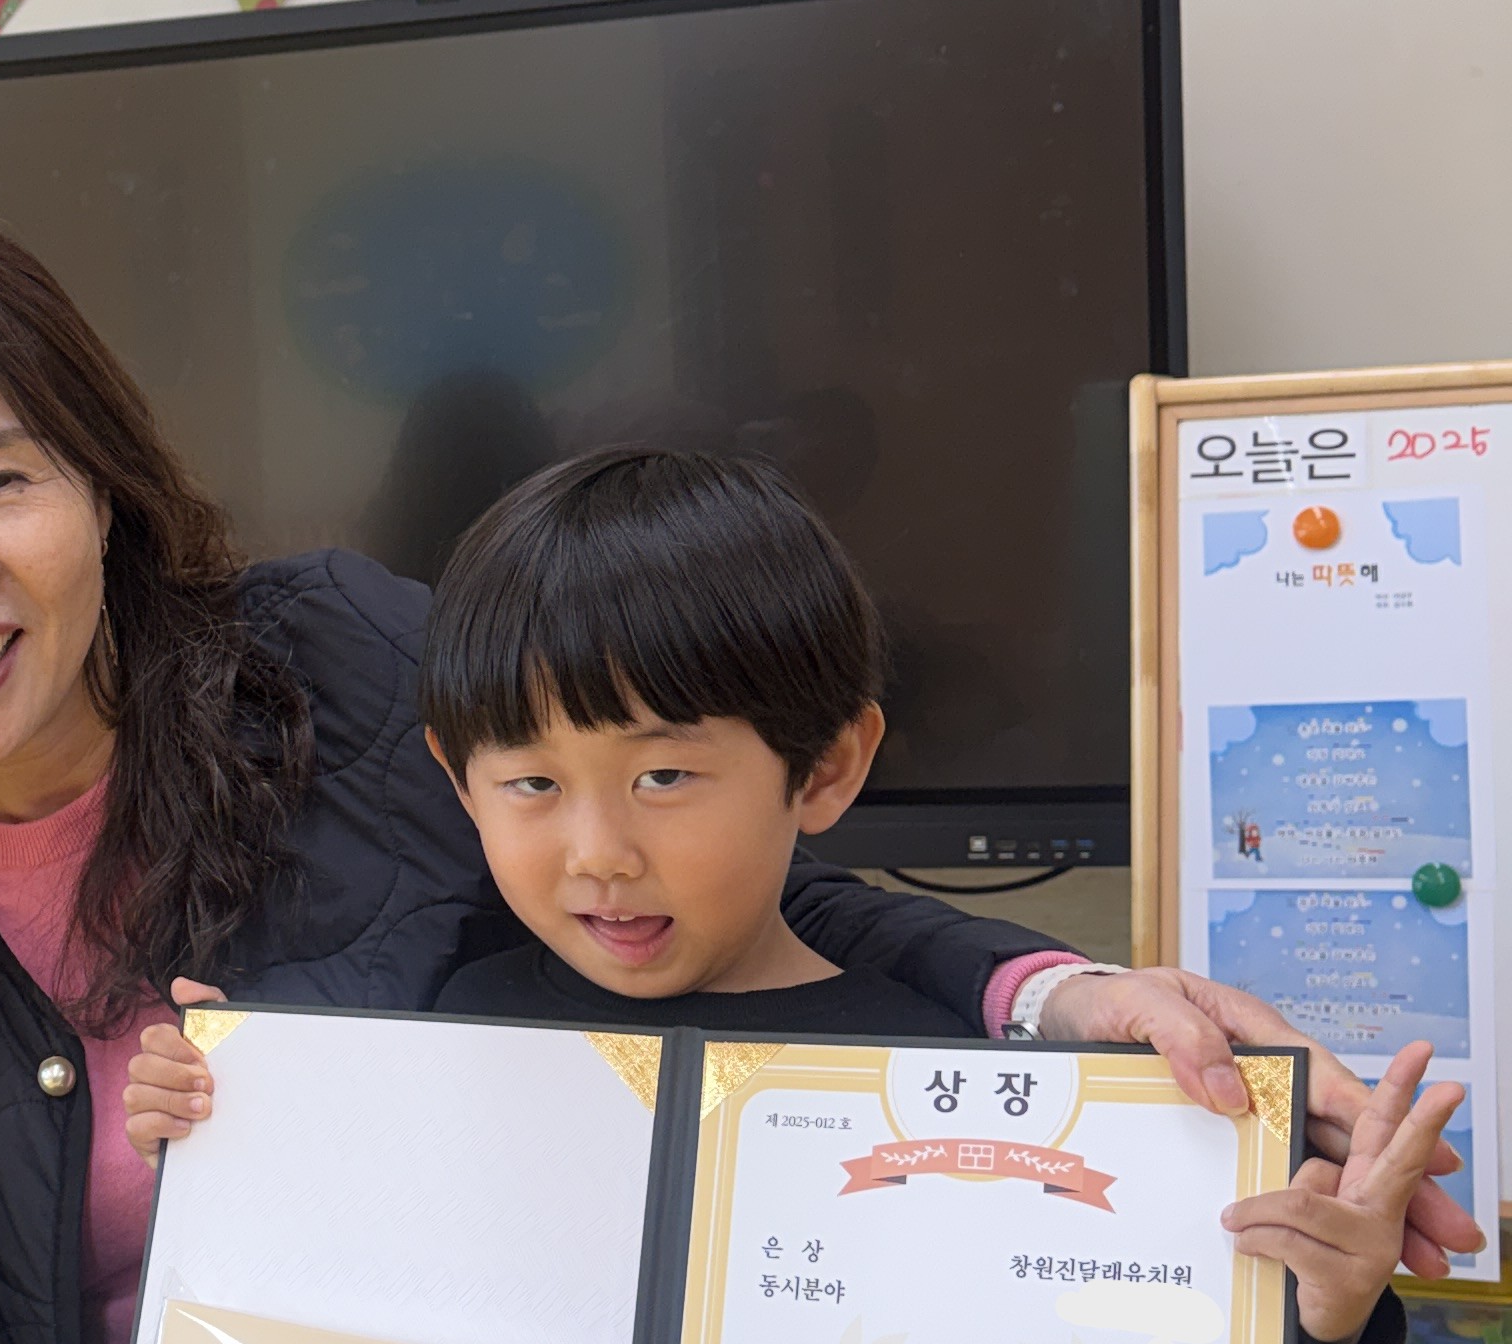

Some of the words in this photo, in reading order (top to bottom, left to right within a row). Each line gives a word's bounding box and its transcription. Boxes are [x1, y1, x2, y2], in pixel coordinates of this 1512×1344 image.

[1190, 428, 1356, 484] 오늘은
[1388, 427, 1490, 461] 2025
[1275, 570, 1305, 588] 나는
[765, 1112, 778, 1127] 제
[780, 1115, 835, 1128] 2025-012
[837, 1116, 852, 1129] 호
[758, 1274, 845, 1304] 동시분야
